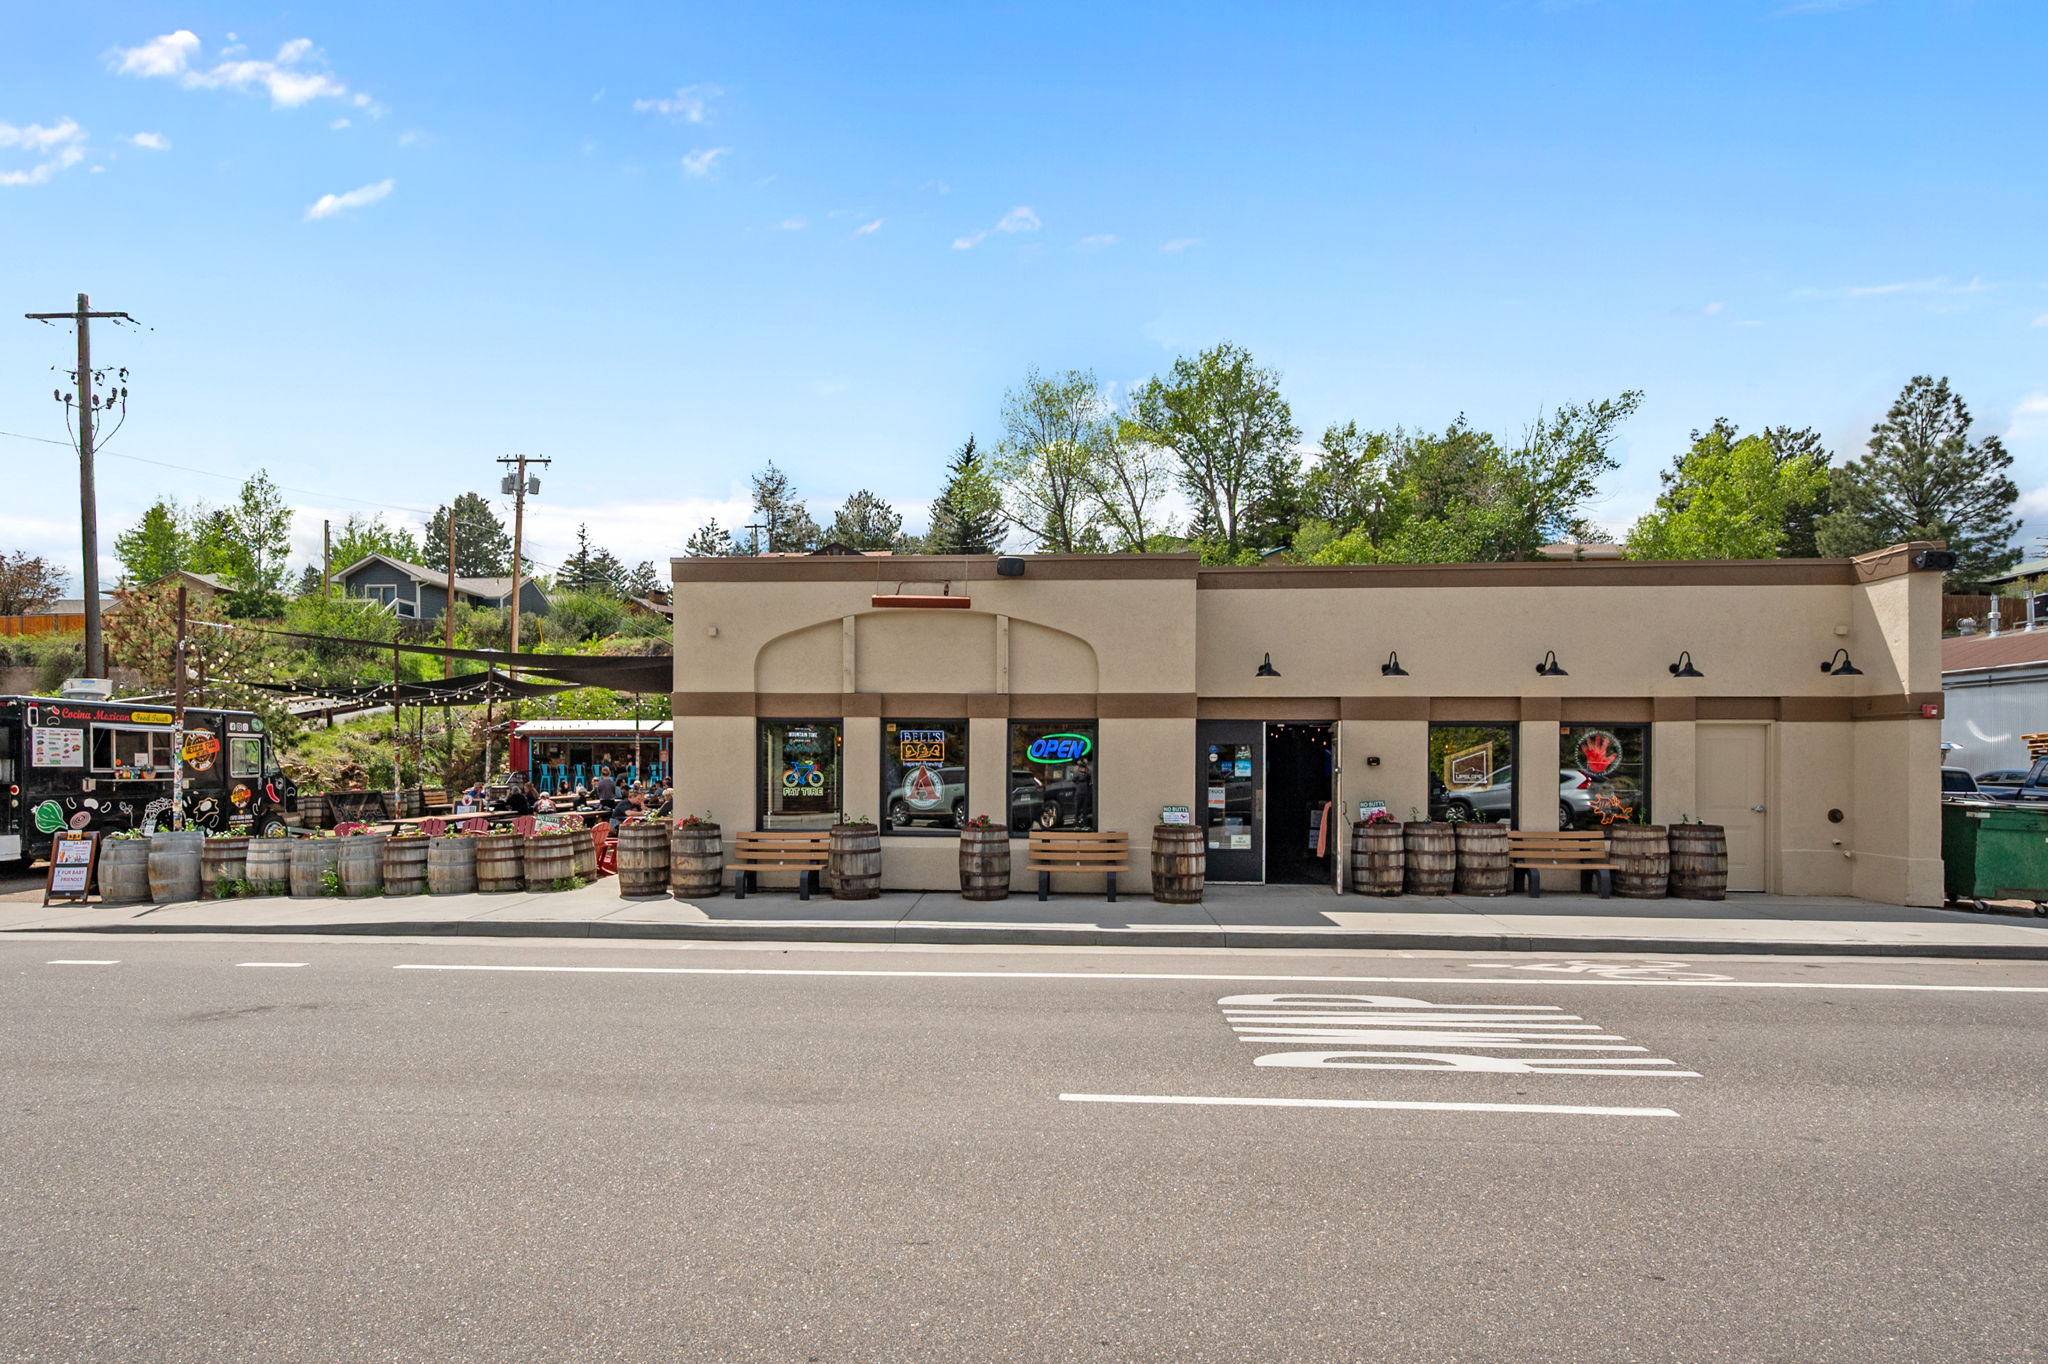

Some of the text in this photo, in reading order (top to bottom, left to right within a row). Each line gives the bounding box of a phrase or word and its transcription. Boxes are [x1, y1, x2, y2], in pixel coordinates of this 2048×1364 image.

[61, 708, 130, 721] Cocina Mexican
[135, 713, 149, 721] Food
[904, 732, 941, 741] BELL'S
[1031, 739, 1085, 759] OPEN
[783, 787, 824, 797] FAT TIRE
